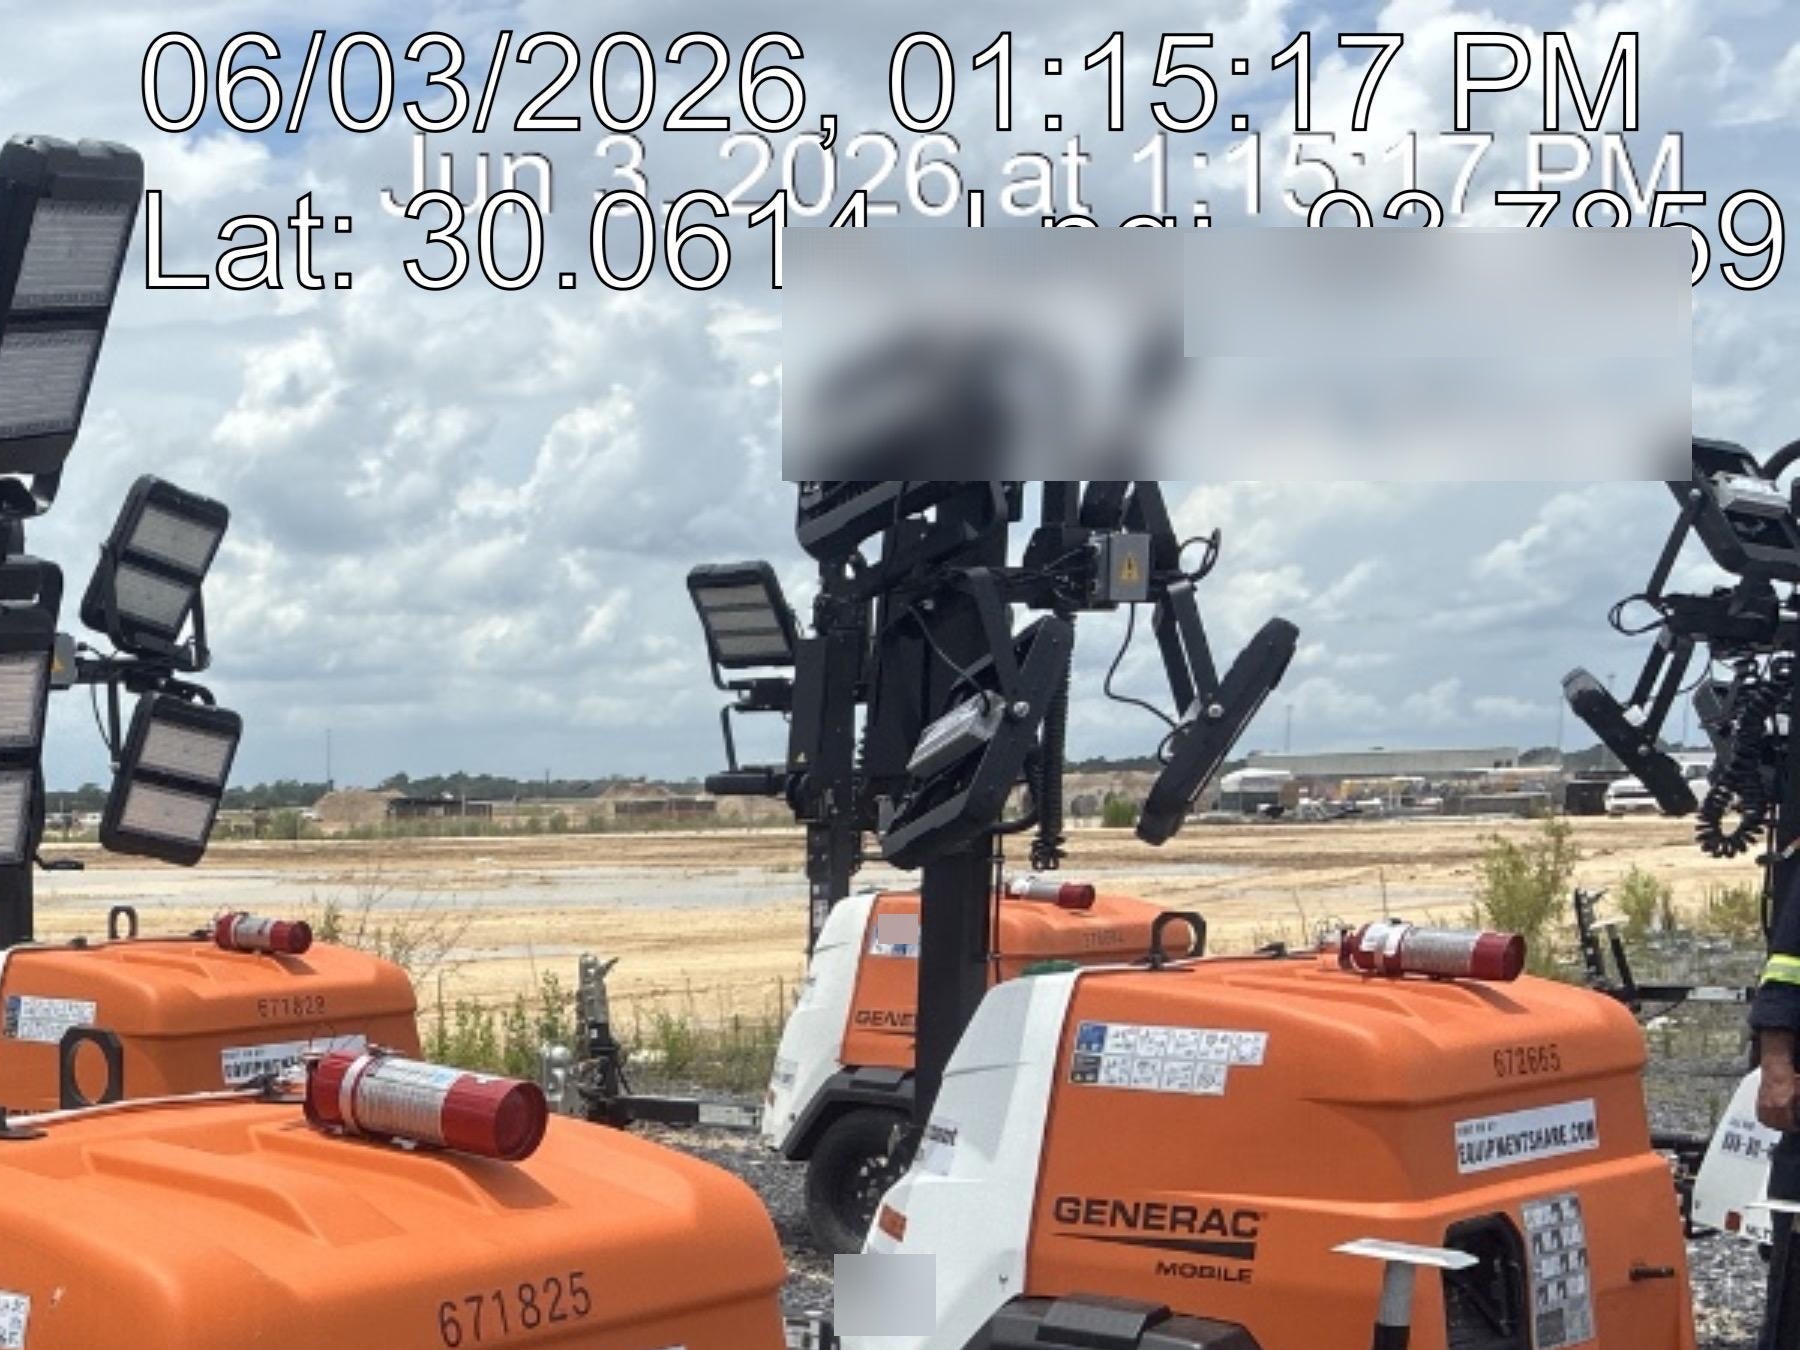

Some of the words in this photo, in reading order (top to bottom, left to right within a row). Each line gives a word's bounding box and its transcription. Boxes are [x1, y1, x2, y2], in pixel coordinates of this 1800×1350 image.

[1054, 1197, 1260, 1237] GENERAC
[1155, 1260, 1254, 1283] MOBILE
[438, 1272, 592, 1347] 671825
